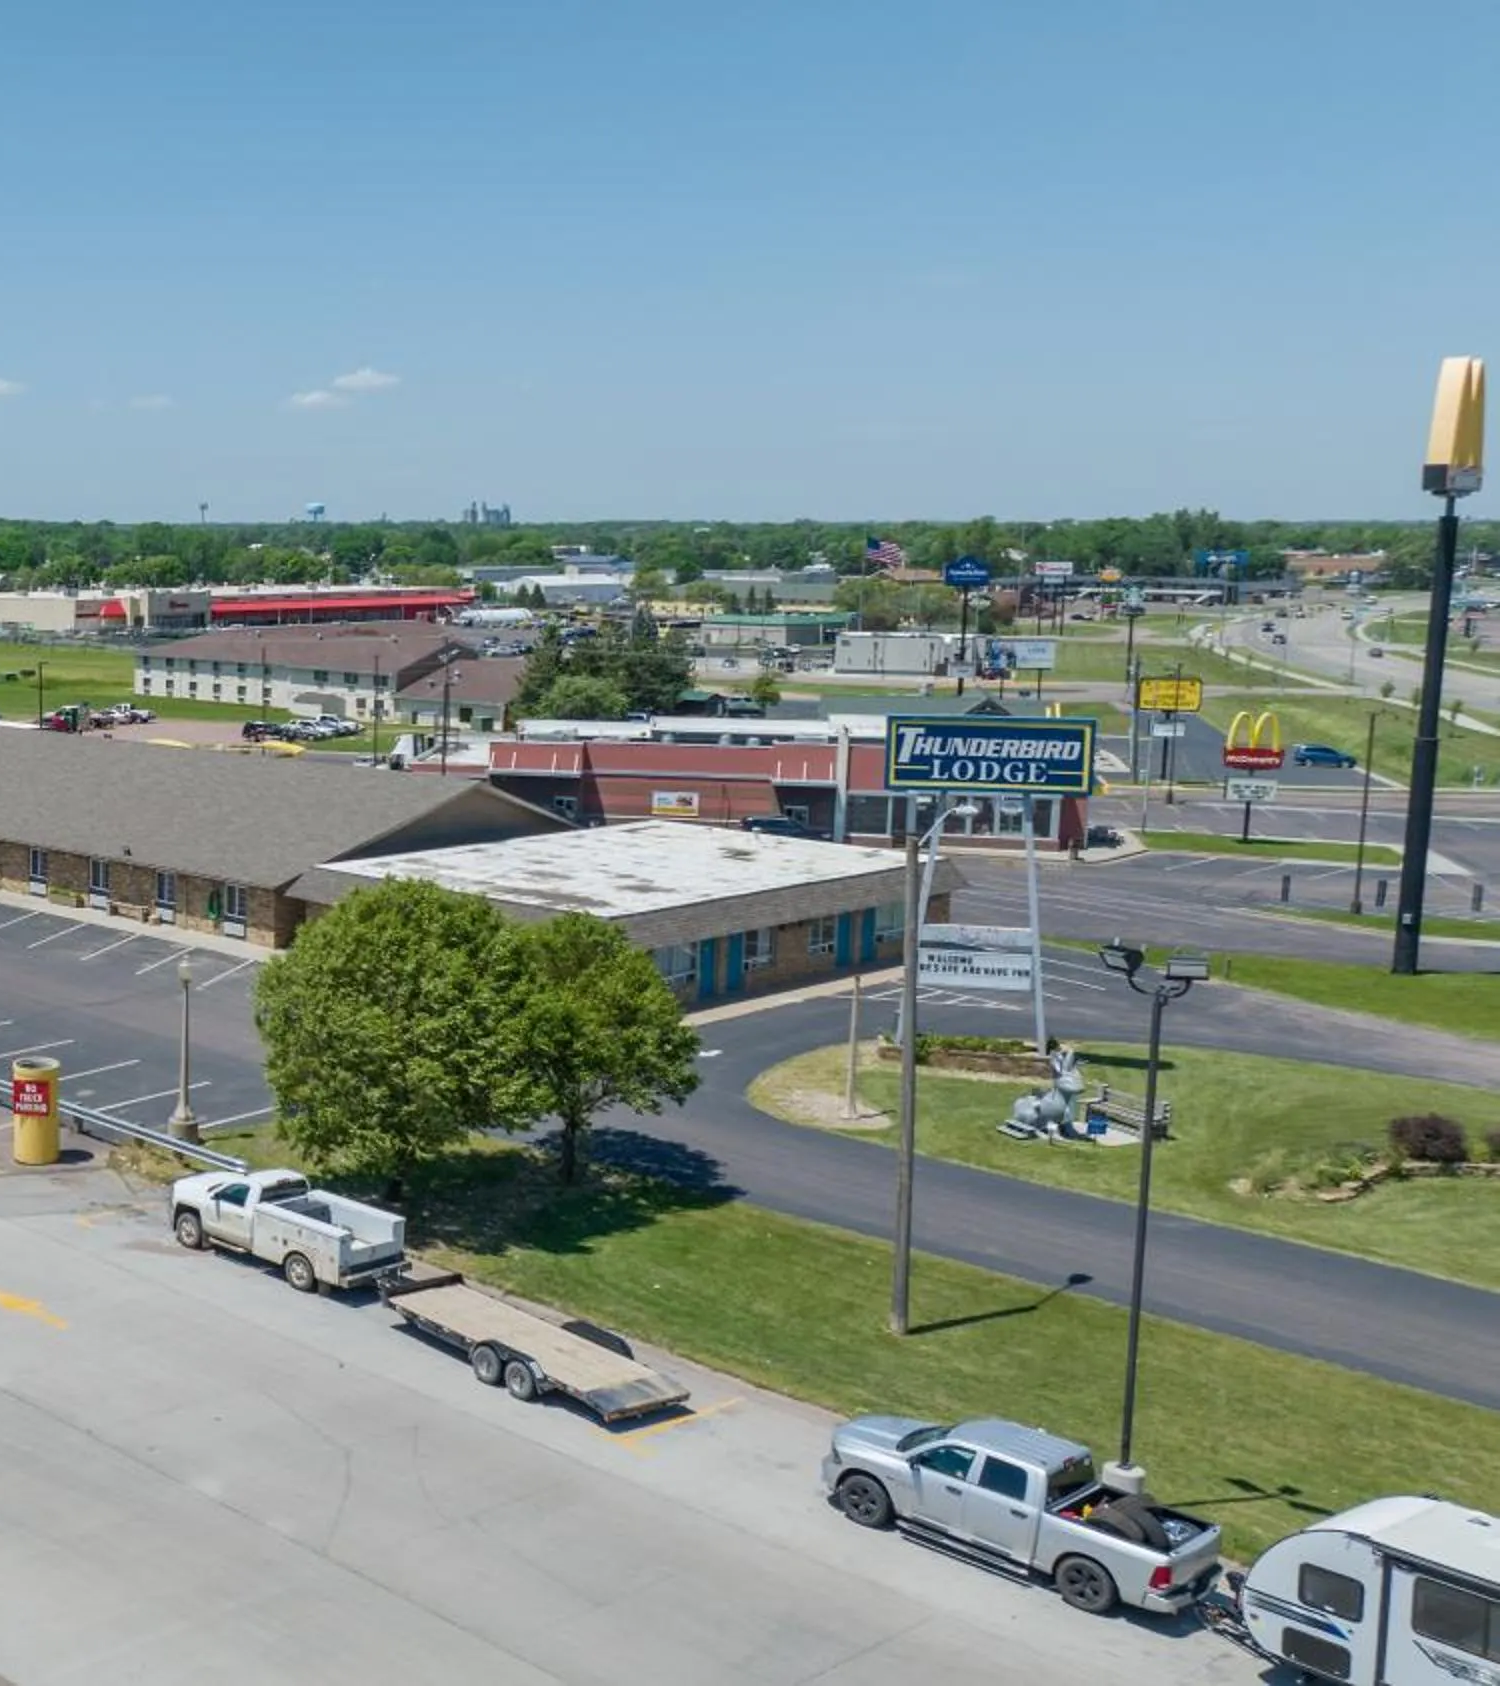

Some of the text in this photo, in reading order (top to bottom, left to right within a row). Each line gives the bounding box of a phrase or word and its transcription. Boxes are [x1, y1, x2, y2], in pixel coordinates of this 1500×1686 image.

[897, 727, 1081, 763] THUNDERBIRD
[929, 758, 1048, 783] LODGE
[25, 1083, 37, 1093] NO
[20, 1093, 43, 1103] TRUCK
[15, 1102, 48, 1113] PARKING
